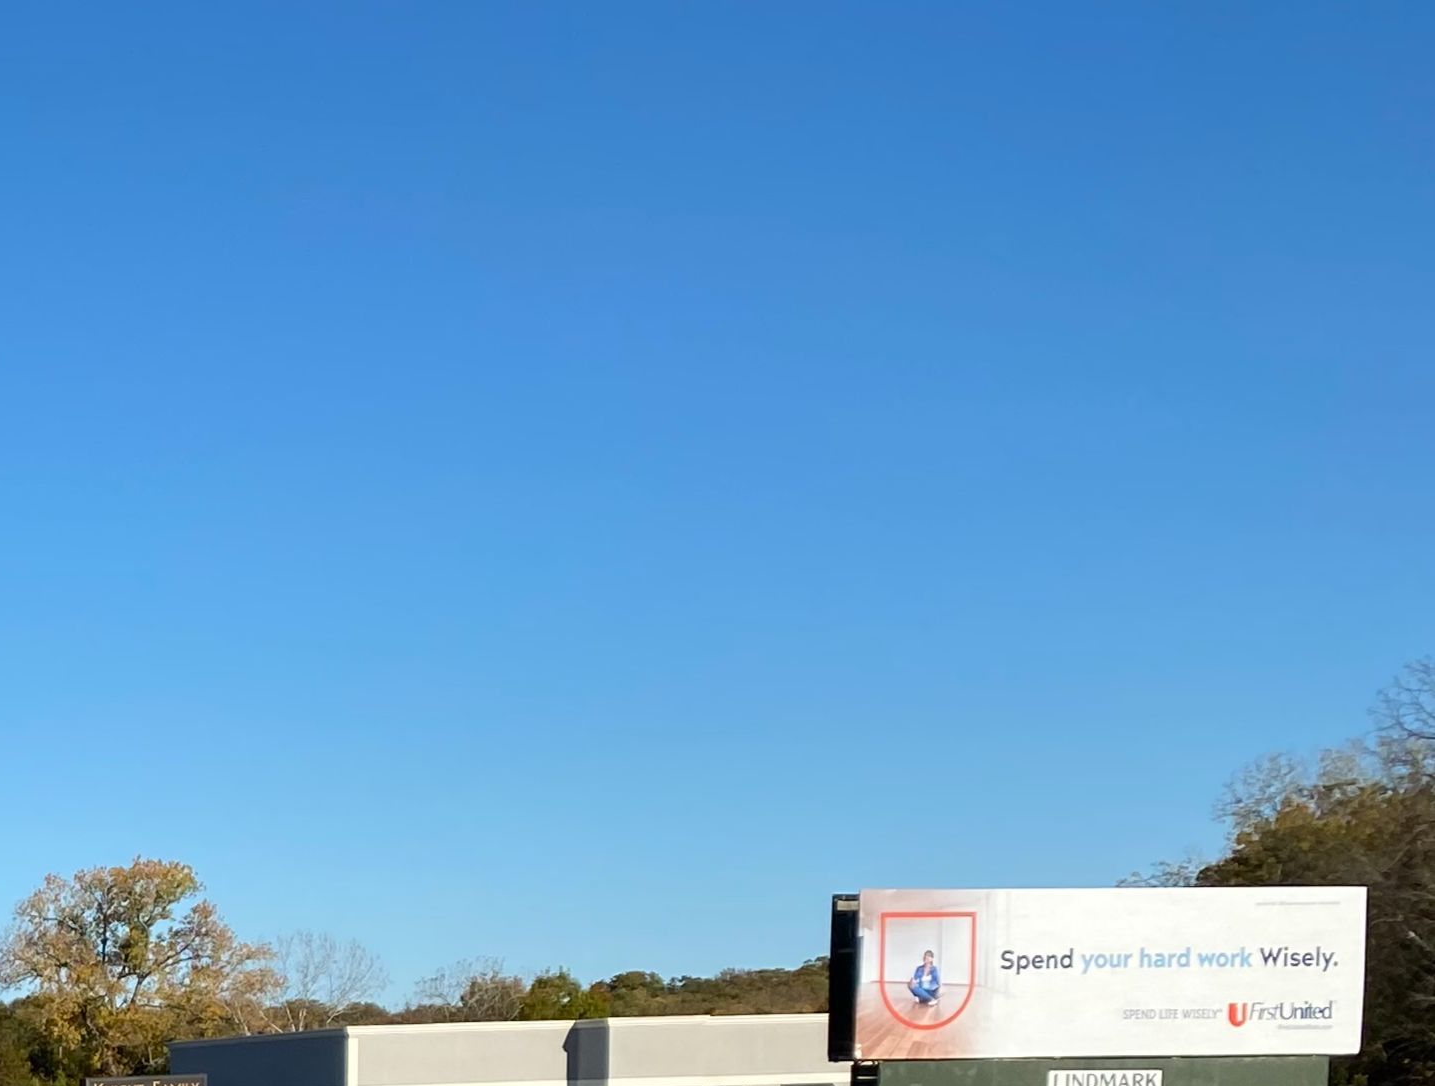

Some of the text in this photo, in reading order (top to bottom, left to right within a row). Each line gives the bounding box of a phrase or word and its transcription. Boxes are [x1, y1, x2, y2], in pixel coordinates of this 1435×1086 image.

[1000, 946, 1339, 975] Spend your hard work Wisely.
[1122, 1008, 1157, 1020] SPEND
[1159, 1008, 1180, 1020] LIFE
